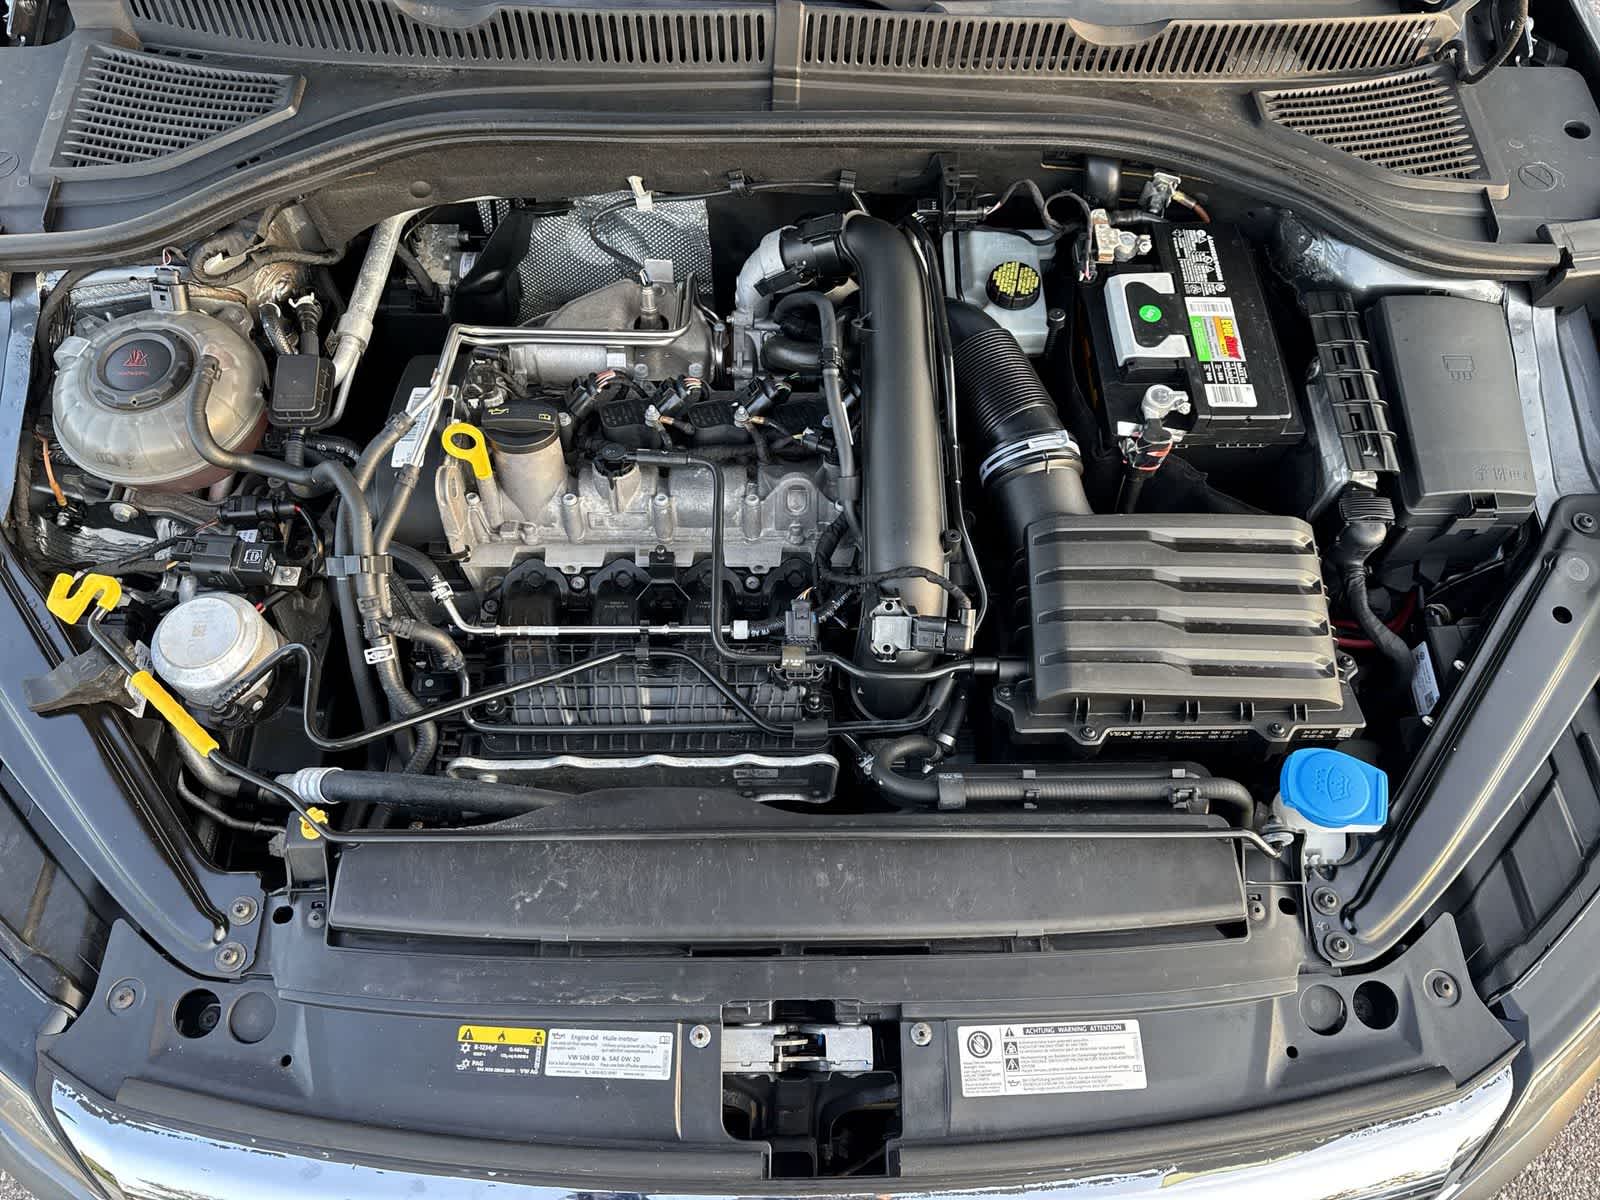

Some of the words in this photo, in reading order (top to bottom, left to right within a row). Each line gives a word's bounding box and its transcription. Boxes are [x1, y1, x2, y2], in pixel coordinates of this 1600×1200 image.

[1025, 1026, 1055, 1035] ACHTUNG
[1058, 1025, 1087, 1033] WARNING
[1090, 1024, 1122, 1032] ATTENTION
[571, 1034, 589, 1042] Engine
